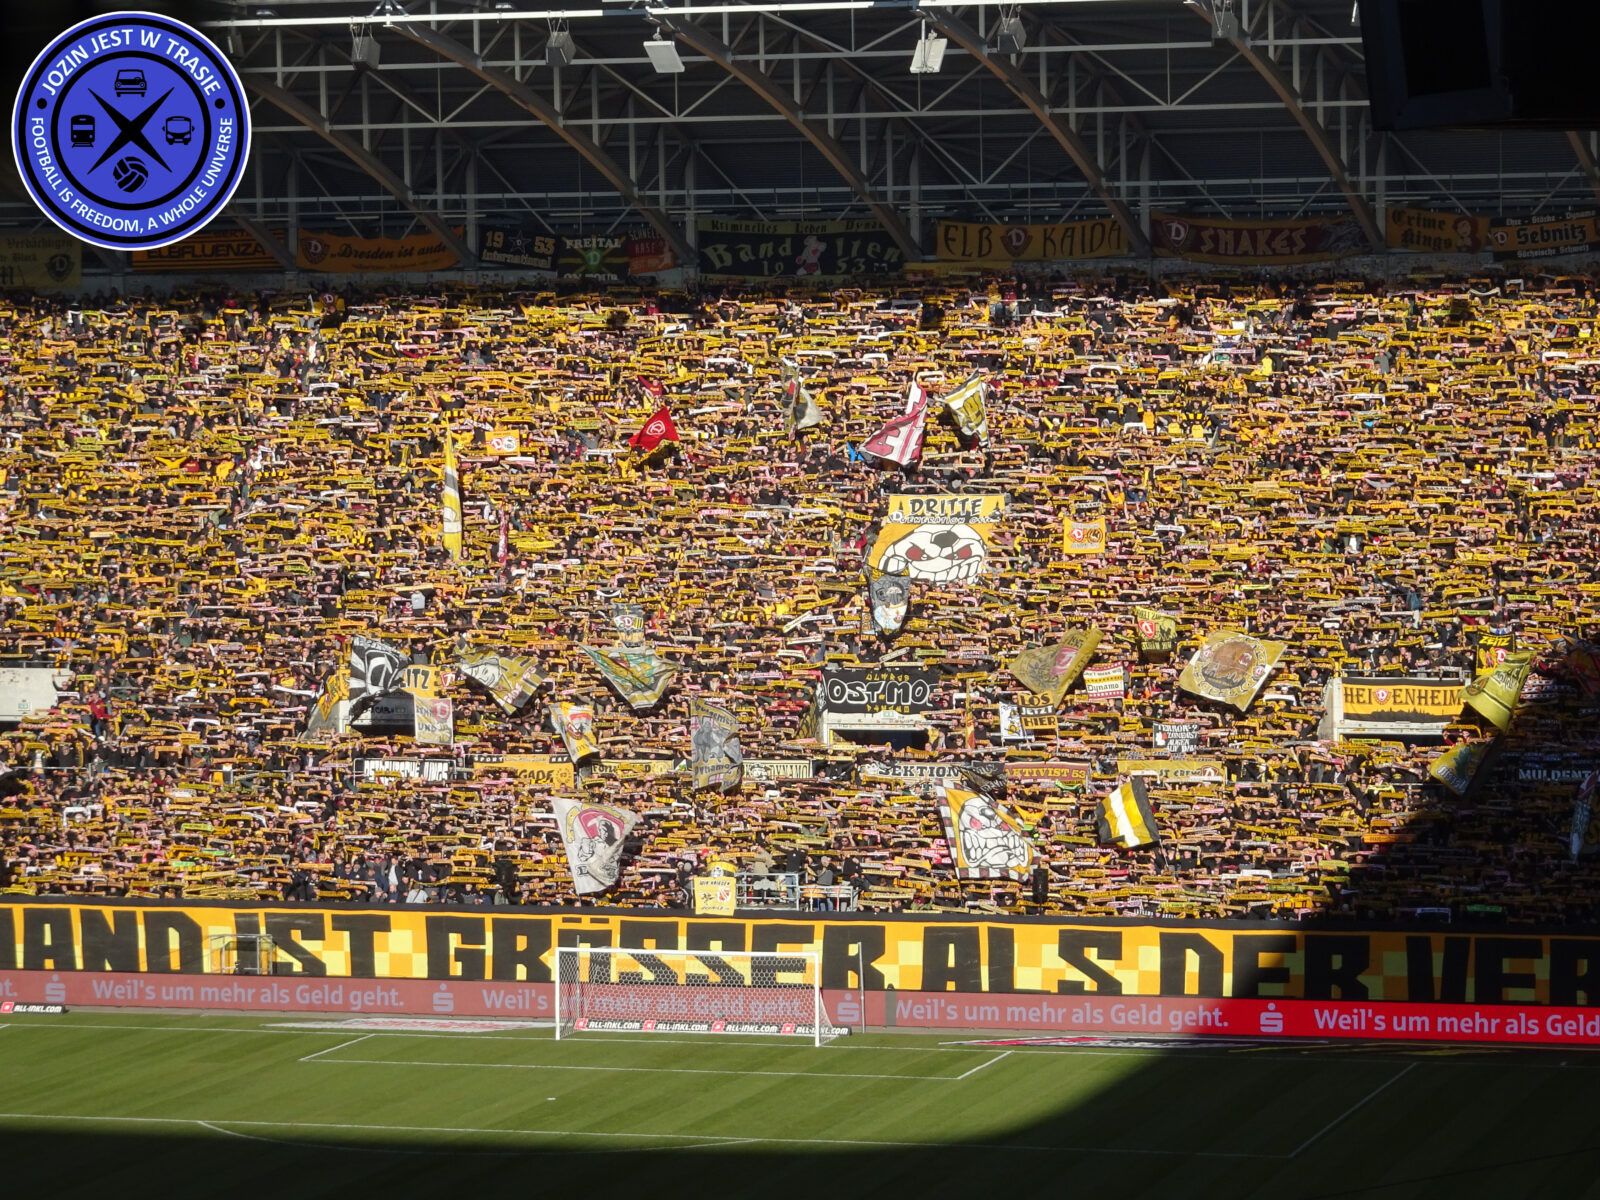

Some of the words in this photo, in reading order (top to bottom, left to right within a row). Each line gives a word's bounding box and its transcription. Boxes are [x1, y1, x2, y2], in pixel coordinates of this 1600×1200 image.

[486, 231, 504, 249] 19
[565, 236, 621, 250] FREITAL
[944, 225, 992, 258] ELB
[1043, 220, 1121, 257] KAIDA
[1200, 227, 1307, 255] SNAKES
[1516, 223, 1587, 245] Sebnitz
[534, 235, 555, 256] 53
[909, 497, 984, 517] DRITTE
[1478, 635, 1512, 647] ZEITZ
[1088, 684, 1119, 692] Dynamo
[1020, 693, 1051, 706] LOS
[1021, 705, 1054, 715] JETZT
[1023, 716, 1056, 727] HIER
[879, 765, 961, 778] SEKTION
[1004, 767, 1069, 778] AKTIVIST
[1071, 769, 1086, 778] 53
[235, 912, 391, 982] IST
[921, 925, 1123, 996] ALS
[1158, 931, 1371, 1003] DER
[92, 978, 156, 1002] Weil's
[167, 984, 197, 1002] um
[200, 980, 257, 1003] mehr
[260, 983, 297, 1005] als
[299, 984, 345, 1005] Geld
[349, 986, 405, 1010] geht.
[482, 988, 548, 1011] Weil's
[593, 990, 650, 1013] mehr
[654, 992, 688, 1014] als
[692, 994, 742, 1016] Geld
[895, 999, 958, 1020] Weil's
[964, 1005, 1000, 1021] um
[1006, 1001, 1067, 1023] mehr
[1071, 1002, 1103, 1025] als
[1110, 1003, 1162, 1026] Geld
[1168, 1005, 1229, 1031] geht.
[1314, 1008, 1387, 1032] Weil's
[1393, 1014, 1431, 1032] um
[1437, 1011, 1501, 1034] mehr
[1504, 1011, 1540, 1035] als
[1546, 1013, 1600, 1037] Geld
